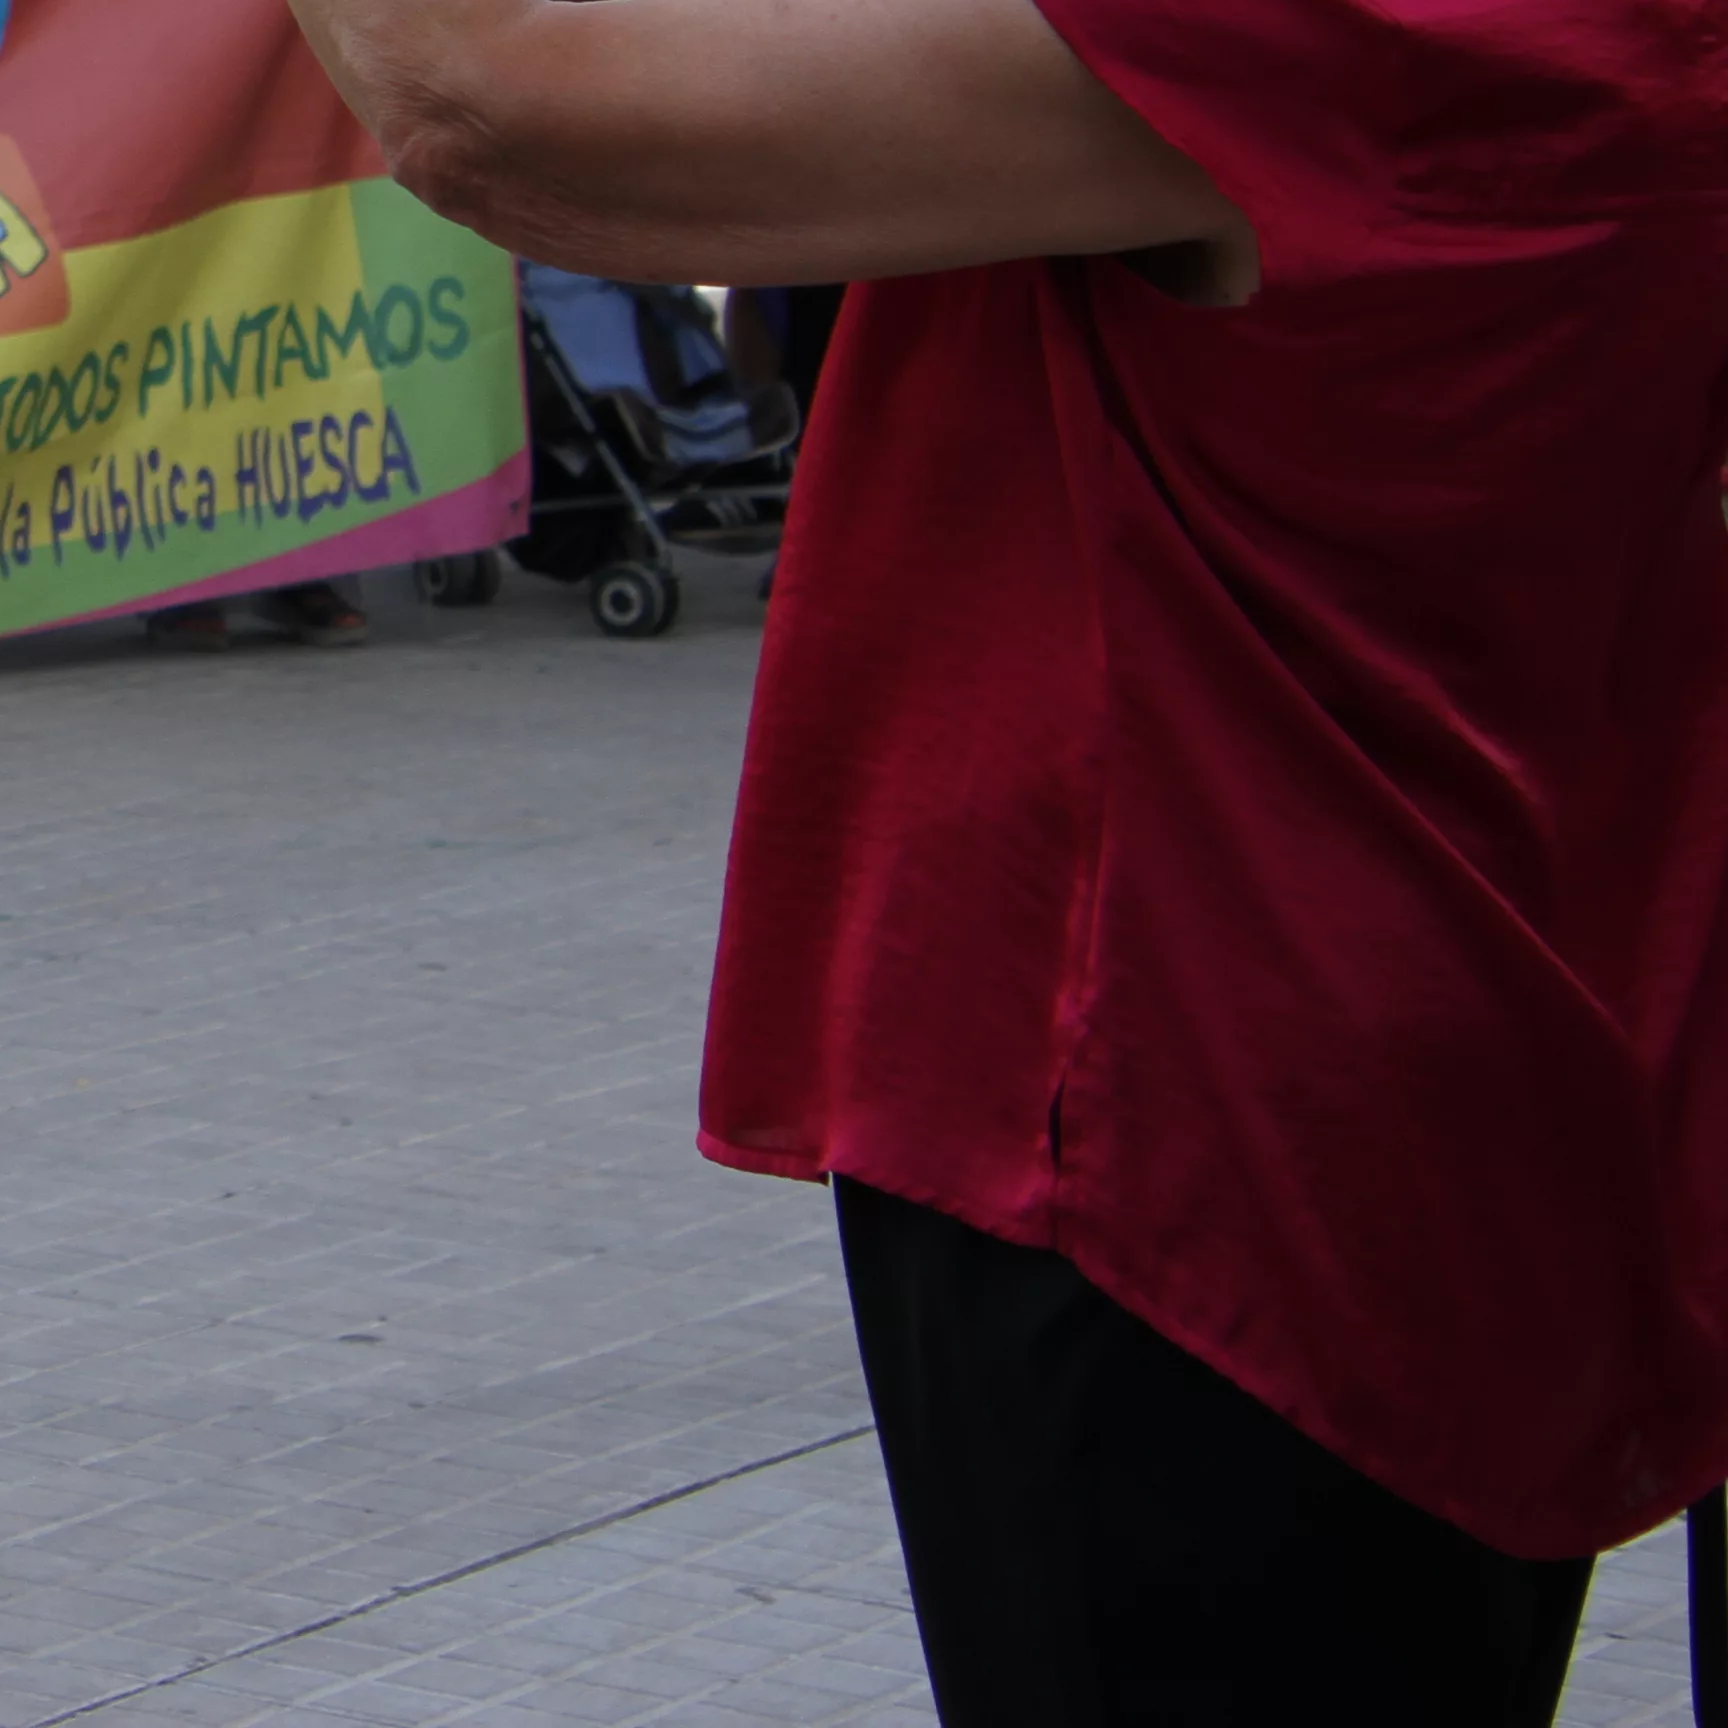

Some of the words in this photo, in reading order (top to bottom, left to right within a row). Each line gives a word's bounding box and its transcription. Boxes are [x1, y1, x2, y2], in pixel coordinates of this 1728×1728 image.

[138, 275, 471, 417] PINTAMOS
[50, 448, 216, 568] Pública
[235, 406, 421, 528] HUESCA
